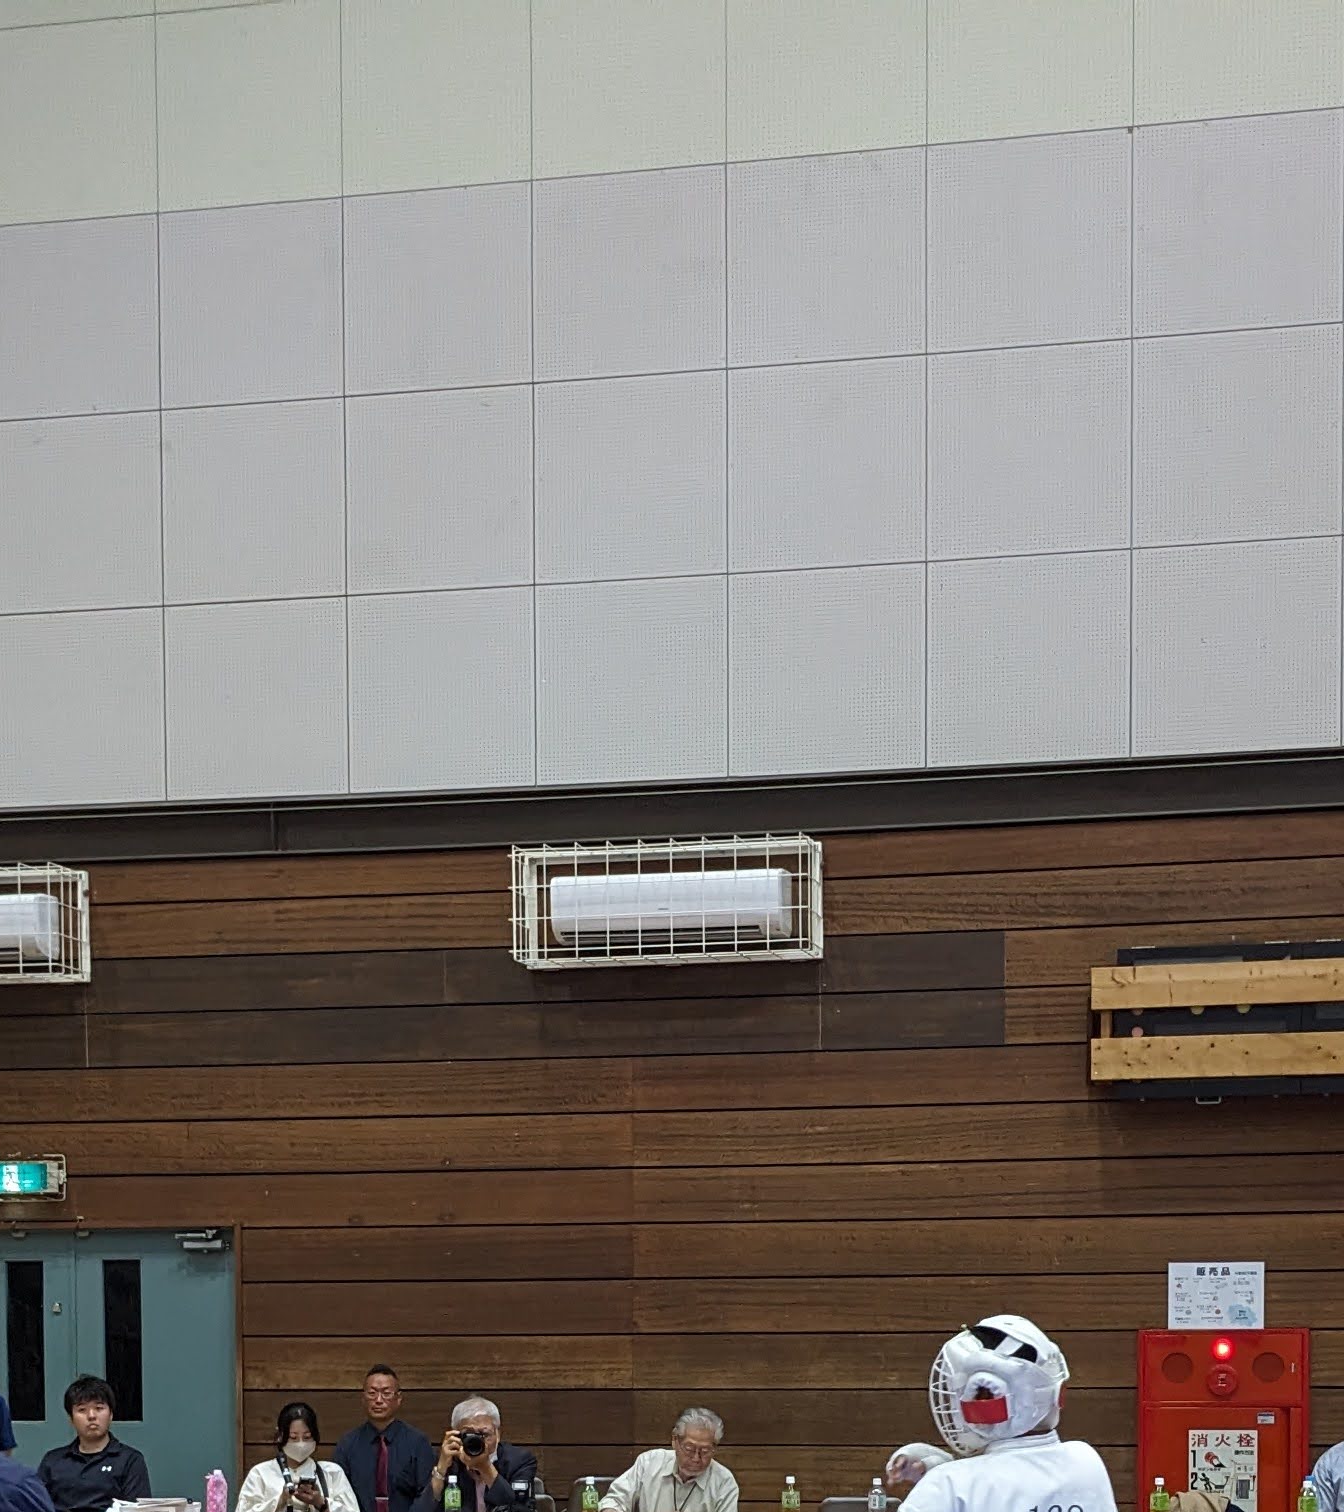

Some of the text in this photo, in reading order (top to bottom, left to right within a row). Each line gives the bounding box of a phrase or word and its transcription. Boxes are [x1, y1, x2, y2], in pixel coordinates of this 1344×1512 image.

[1191, 1433, 1256, 1448] 消火栓
[1190, 1450, 1197, 1468] 1
[1190, 1472, 1198, 1490] 2
